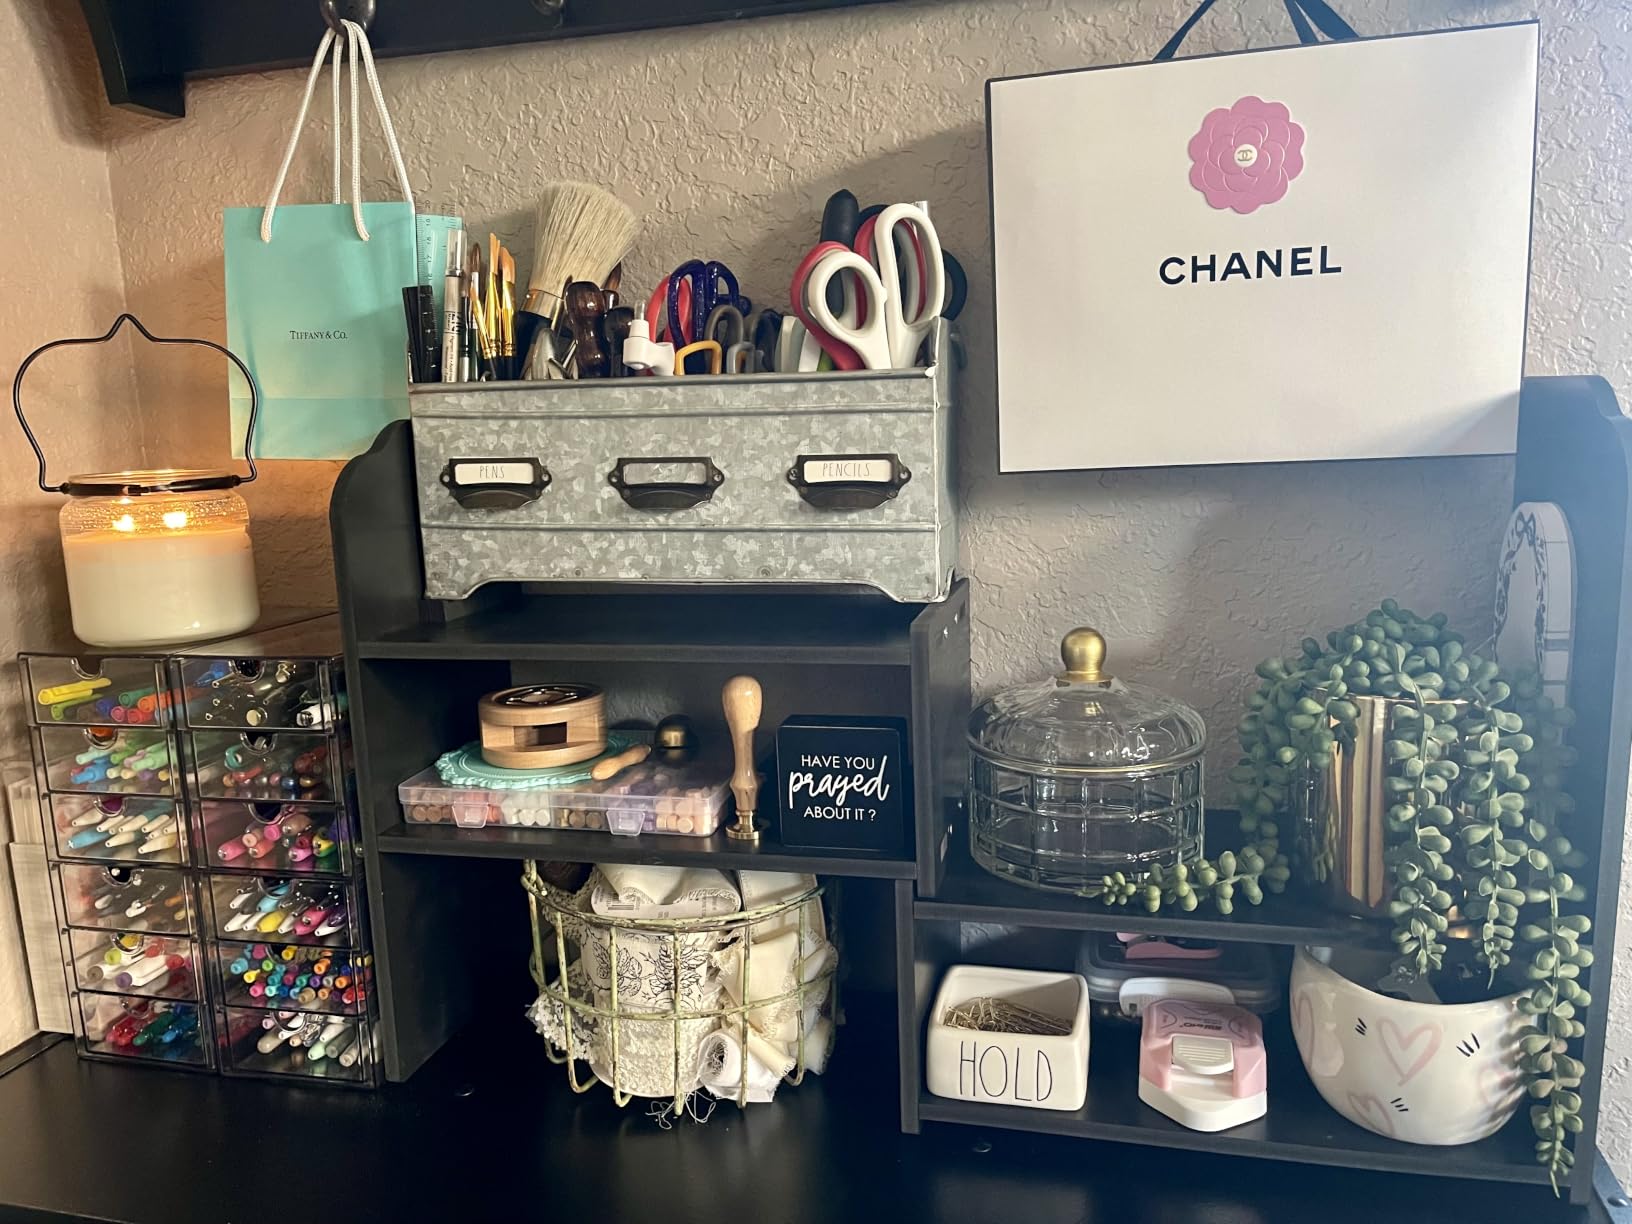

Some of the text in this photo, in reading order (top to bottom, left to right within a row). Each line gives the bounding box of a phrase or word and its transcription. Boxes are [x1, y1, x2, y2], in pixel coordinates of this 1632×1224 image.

[1159, 245, 1342, 285] CHANEL
[289, 330, 325, 340] TIFFANY
[325, 330, 332, 340] &
[479, 465, 505, 479] PENS
[822, 462, 872, 478] PENCILS
[801, 754, 875, 770] HAVE YOU
[789, 755, 890, 809] prayed
[803, 806, 851, 820] ABOUT
[855, 808, 865, 821] IT
[959, 1041, 1053, 1102] HOLD
